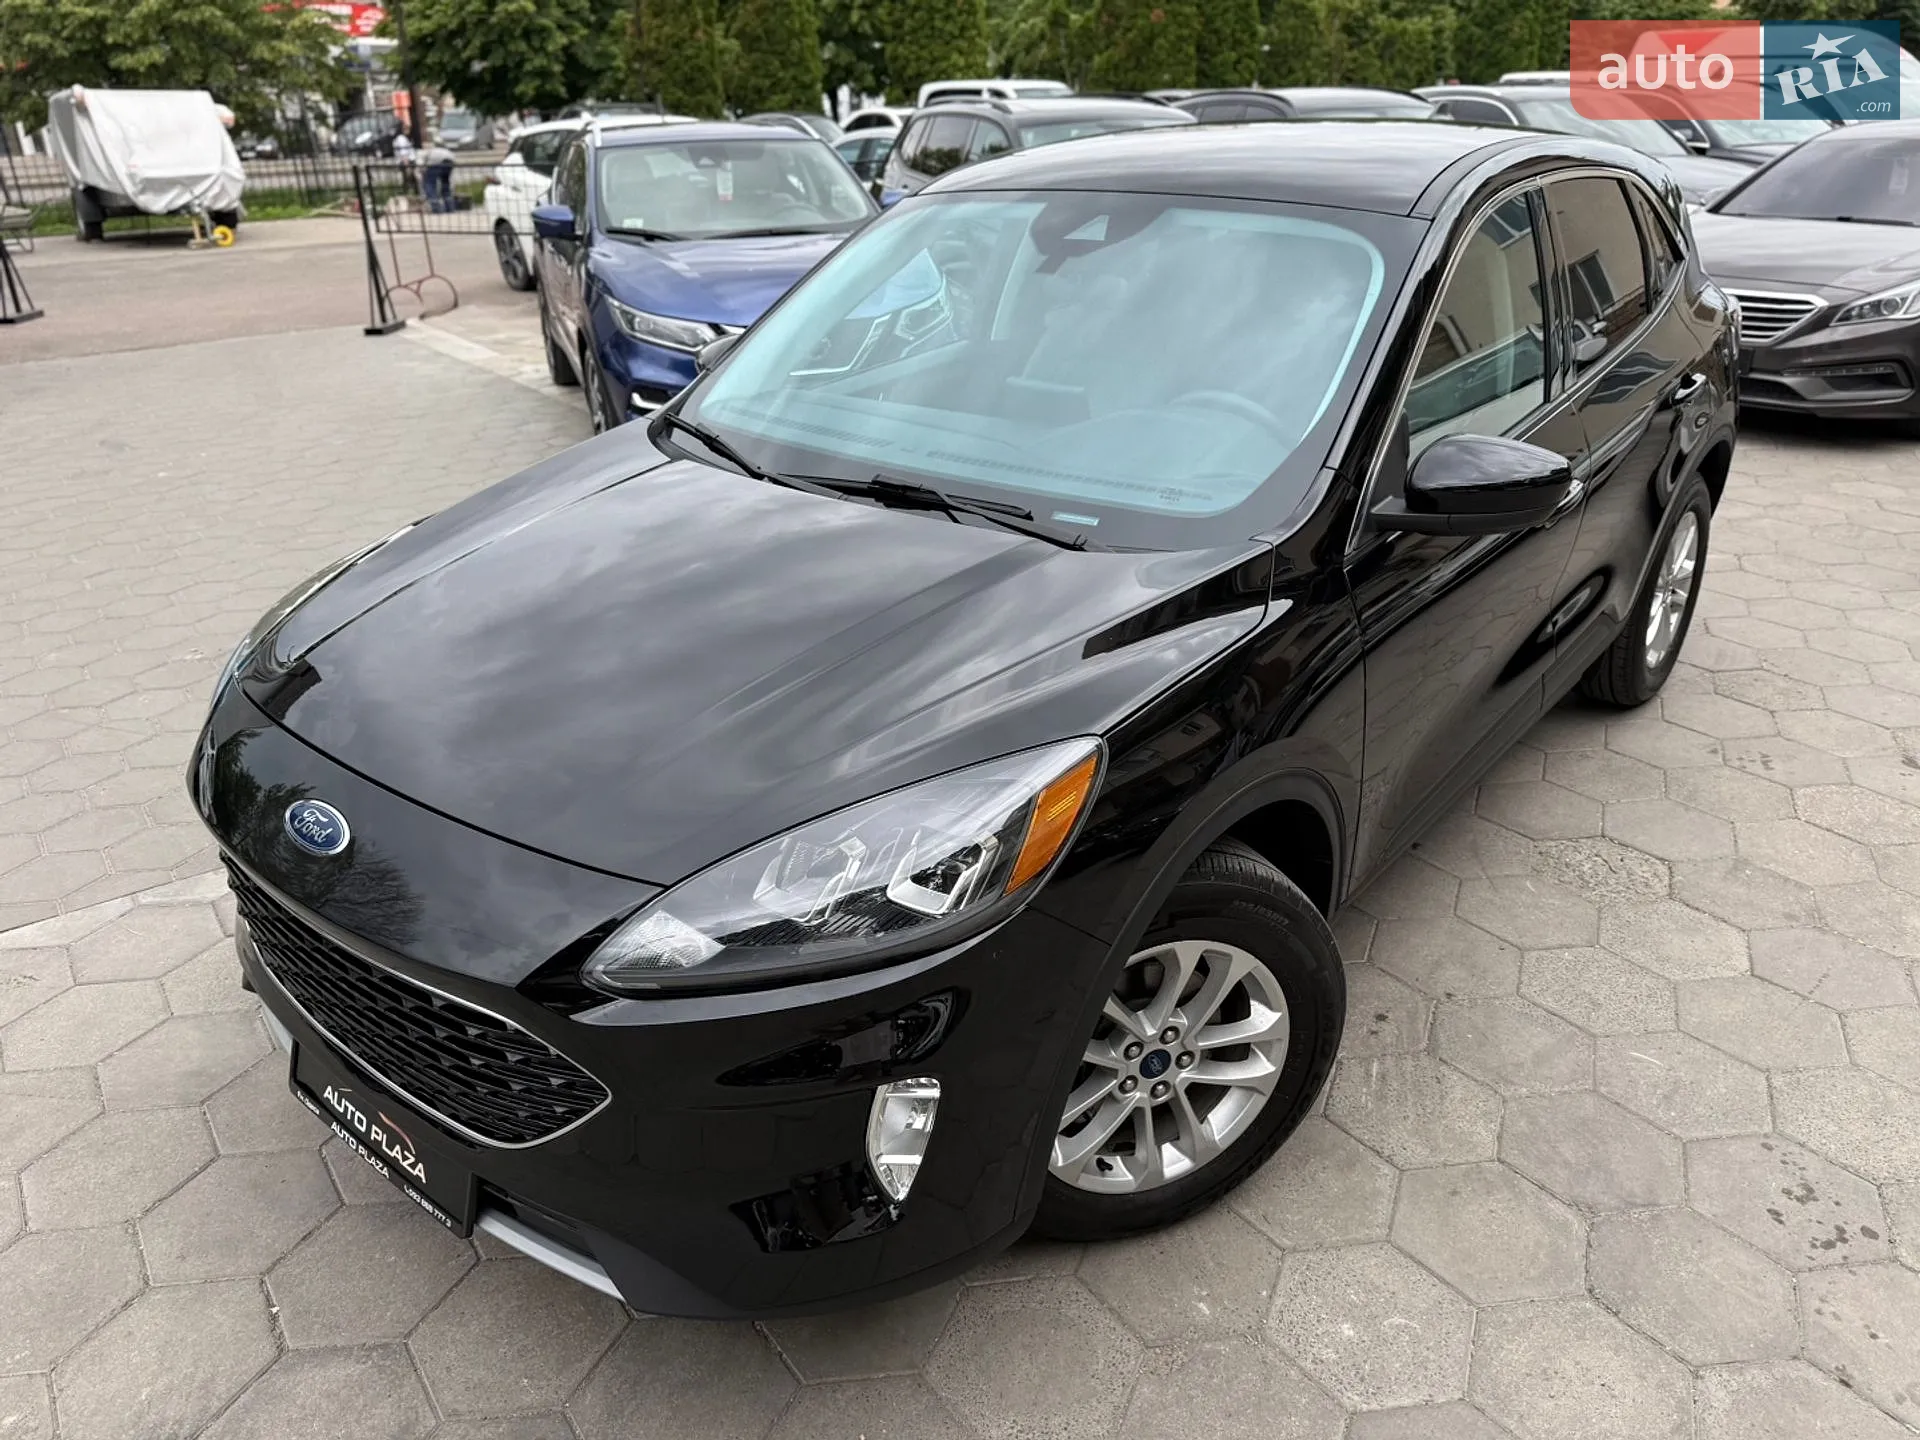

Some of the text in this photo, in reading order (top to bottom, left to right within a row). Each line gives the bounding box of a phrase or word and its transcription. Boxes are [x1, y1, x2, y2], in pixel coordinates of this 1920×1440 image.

[294, 808, 333, 843] Ford
[323, 1085, 366, 1132] AUTO
[371, 1125, 427, 1184] PLAZA
[331, 1121, 390, 1179] AUTO PLAZA
